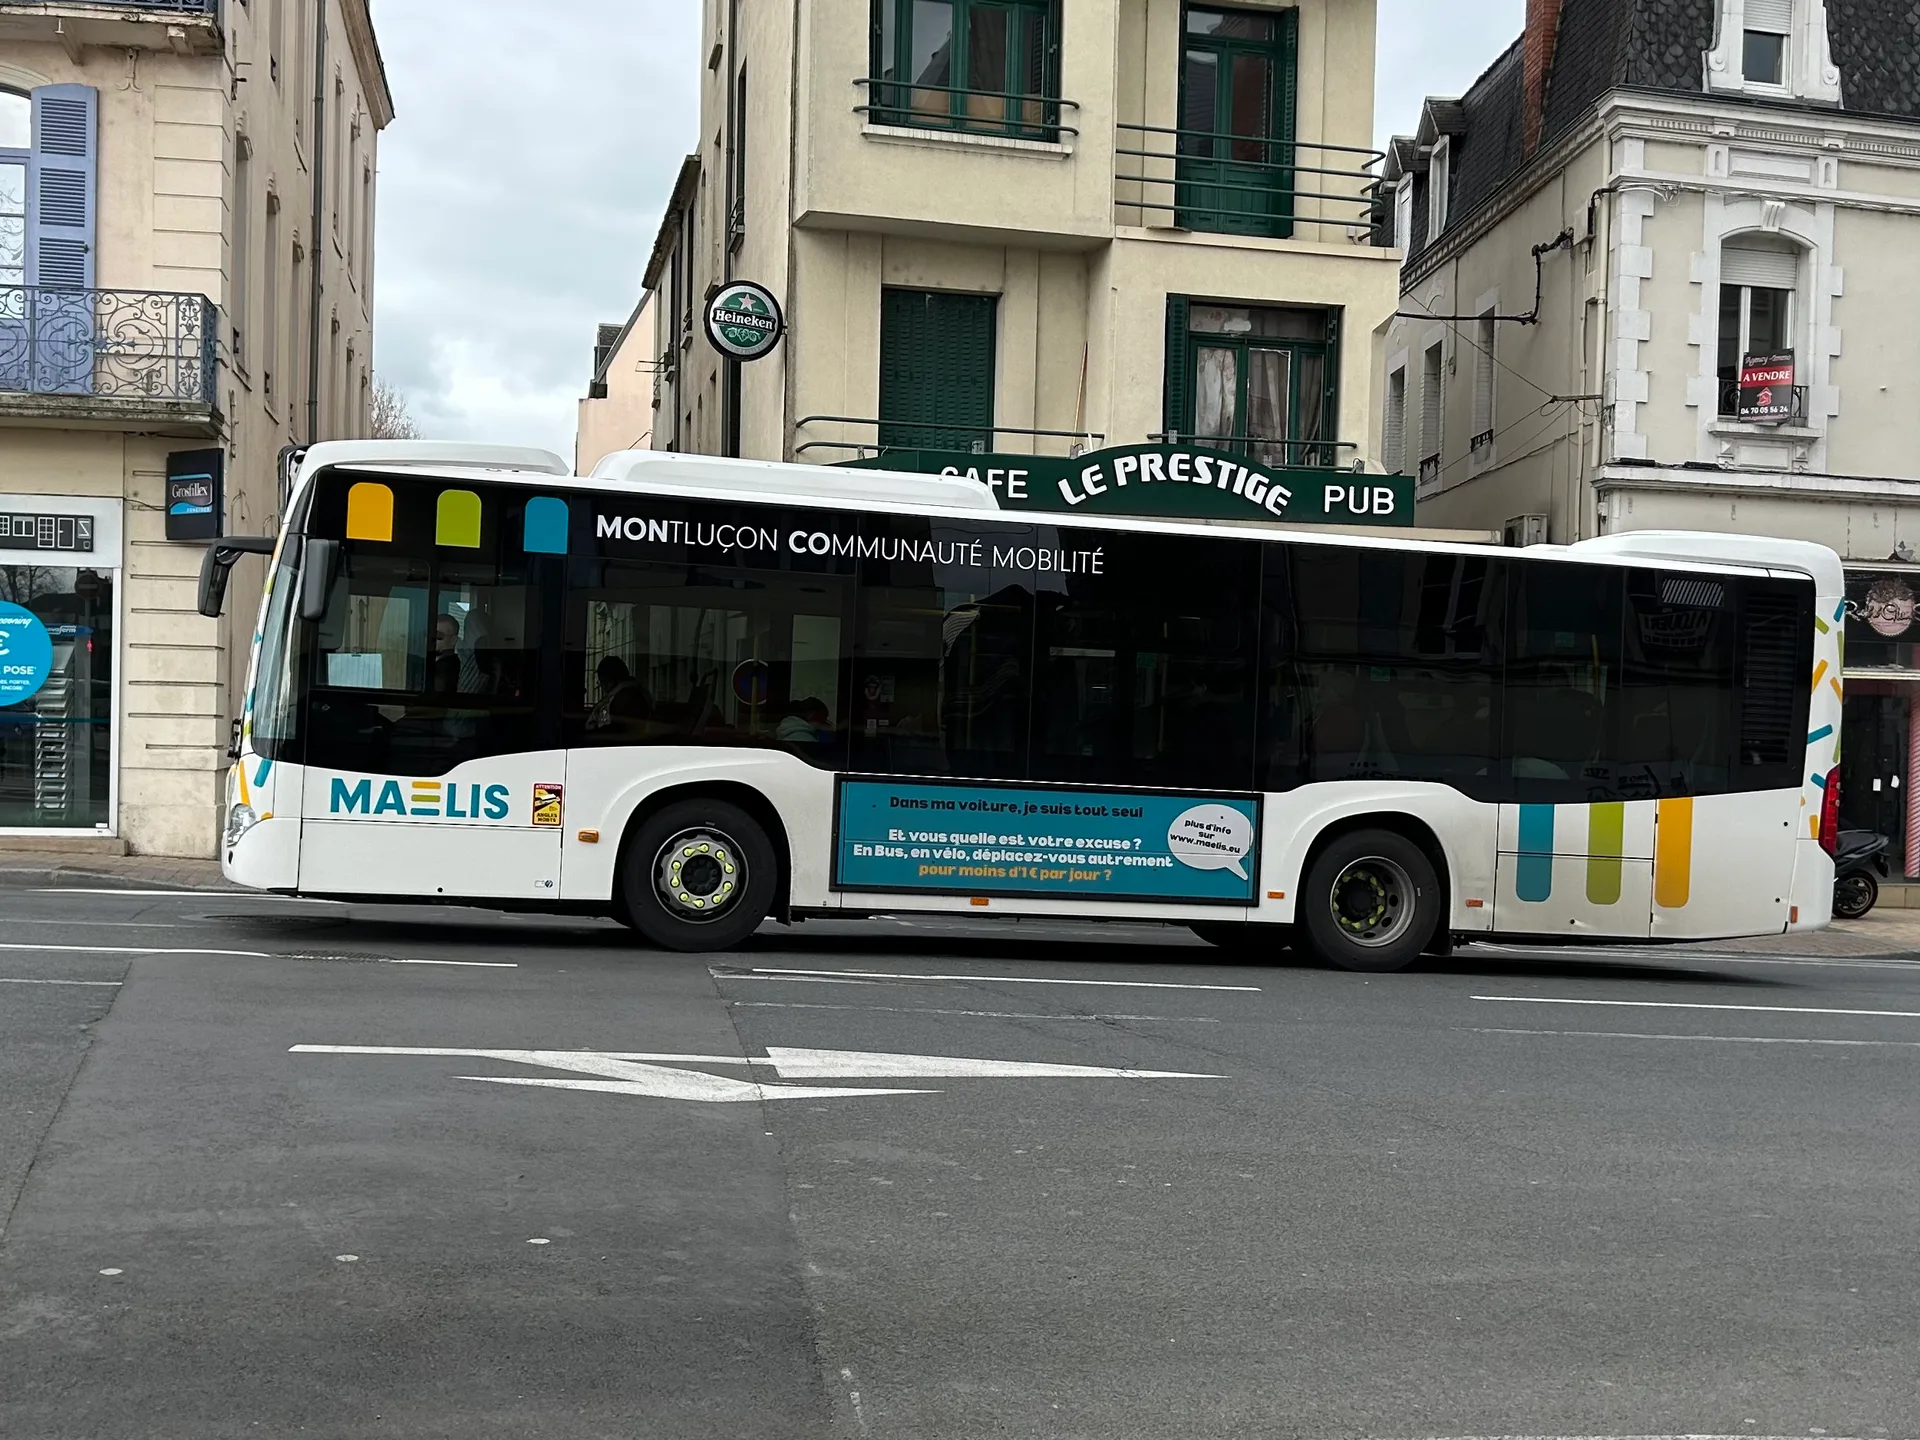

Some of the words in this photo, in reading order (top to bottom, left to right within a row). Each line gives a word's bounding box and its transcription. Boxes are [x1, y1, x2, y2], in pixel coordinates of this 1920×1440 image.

[715, 309, 773, 330] Heineken
[1743, 373, 1751, 382] A
[1752, 371, 1791, 381] VENDRE
[172, 482, 208, 499] Grosfillex
[1058, 464, 1108, 505] LE
[1113, 453, 1292, 516] PRESTIGE
[1323, 485, 1395, 515] PUB
[596, 514, 778, 553] MONTLUÇON
[788, 530, 983, 567] COMMUNAUTÉ
[992, 545, 1105, 575] MOBILITÉ
[330, 777, 510, 820] MAELIS
[890, 796, 928, 809] Dans
[931, 799, 955, 810] ma
[958, 799, 1022, 815] voiture,
[1023, 801, 1038, 816] je
[1040, 802, 1072, 815] suis
[1074, 804, 1109, 817] tout
[1111, 806, 1144, 818] seul
[1184, 819, 1205, 830] plus
[1205, 823, 1232, 835] d'info
[1198, 831, 1215, 840] sur
[888, 828, 906, 842] Et
[908, 831, 948, 843] vous
[949, 832, 996, 846] quelle
[998, 834, 1025, 846] est
[1027, 835, 1074, 848] votre
[1075, 838, 1131, 850] excuse
[1132, 838, 1142, 850] ?
[1170, 833, 1241, 854] www.maelis.eu
[853, 844, 873, 856] En
[874, 845, 909, 859] Bus,
[910, 848, 930, 859] en
[932, 847, 970, 862] vélo,
[972, 848, 1086, 864] déplacez-vous
[1087, 853, 1174, 867] autrement
[918, 864, 957, 877] pour
[958, 864, 1006, 877] moins
[1039, 868, 1067, 881] par
[1068, 867, 1101, 883] jour
[1101, 869, 1112, 881] ?
